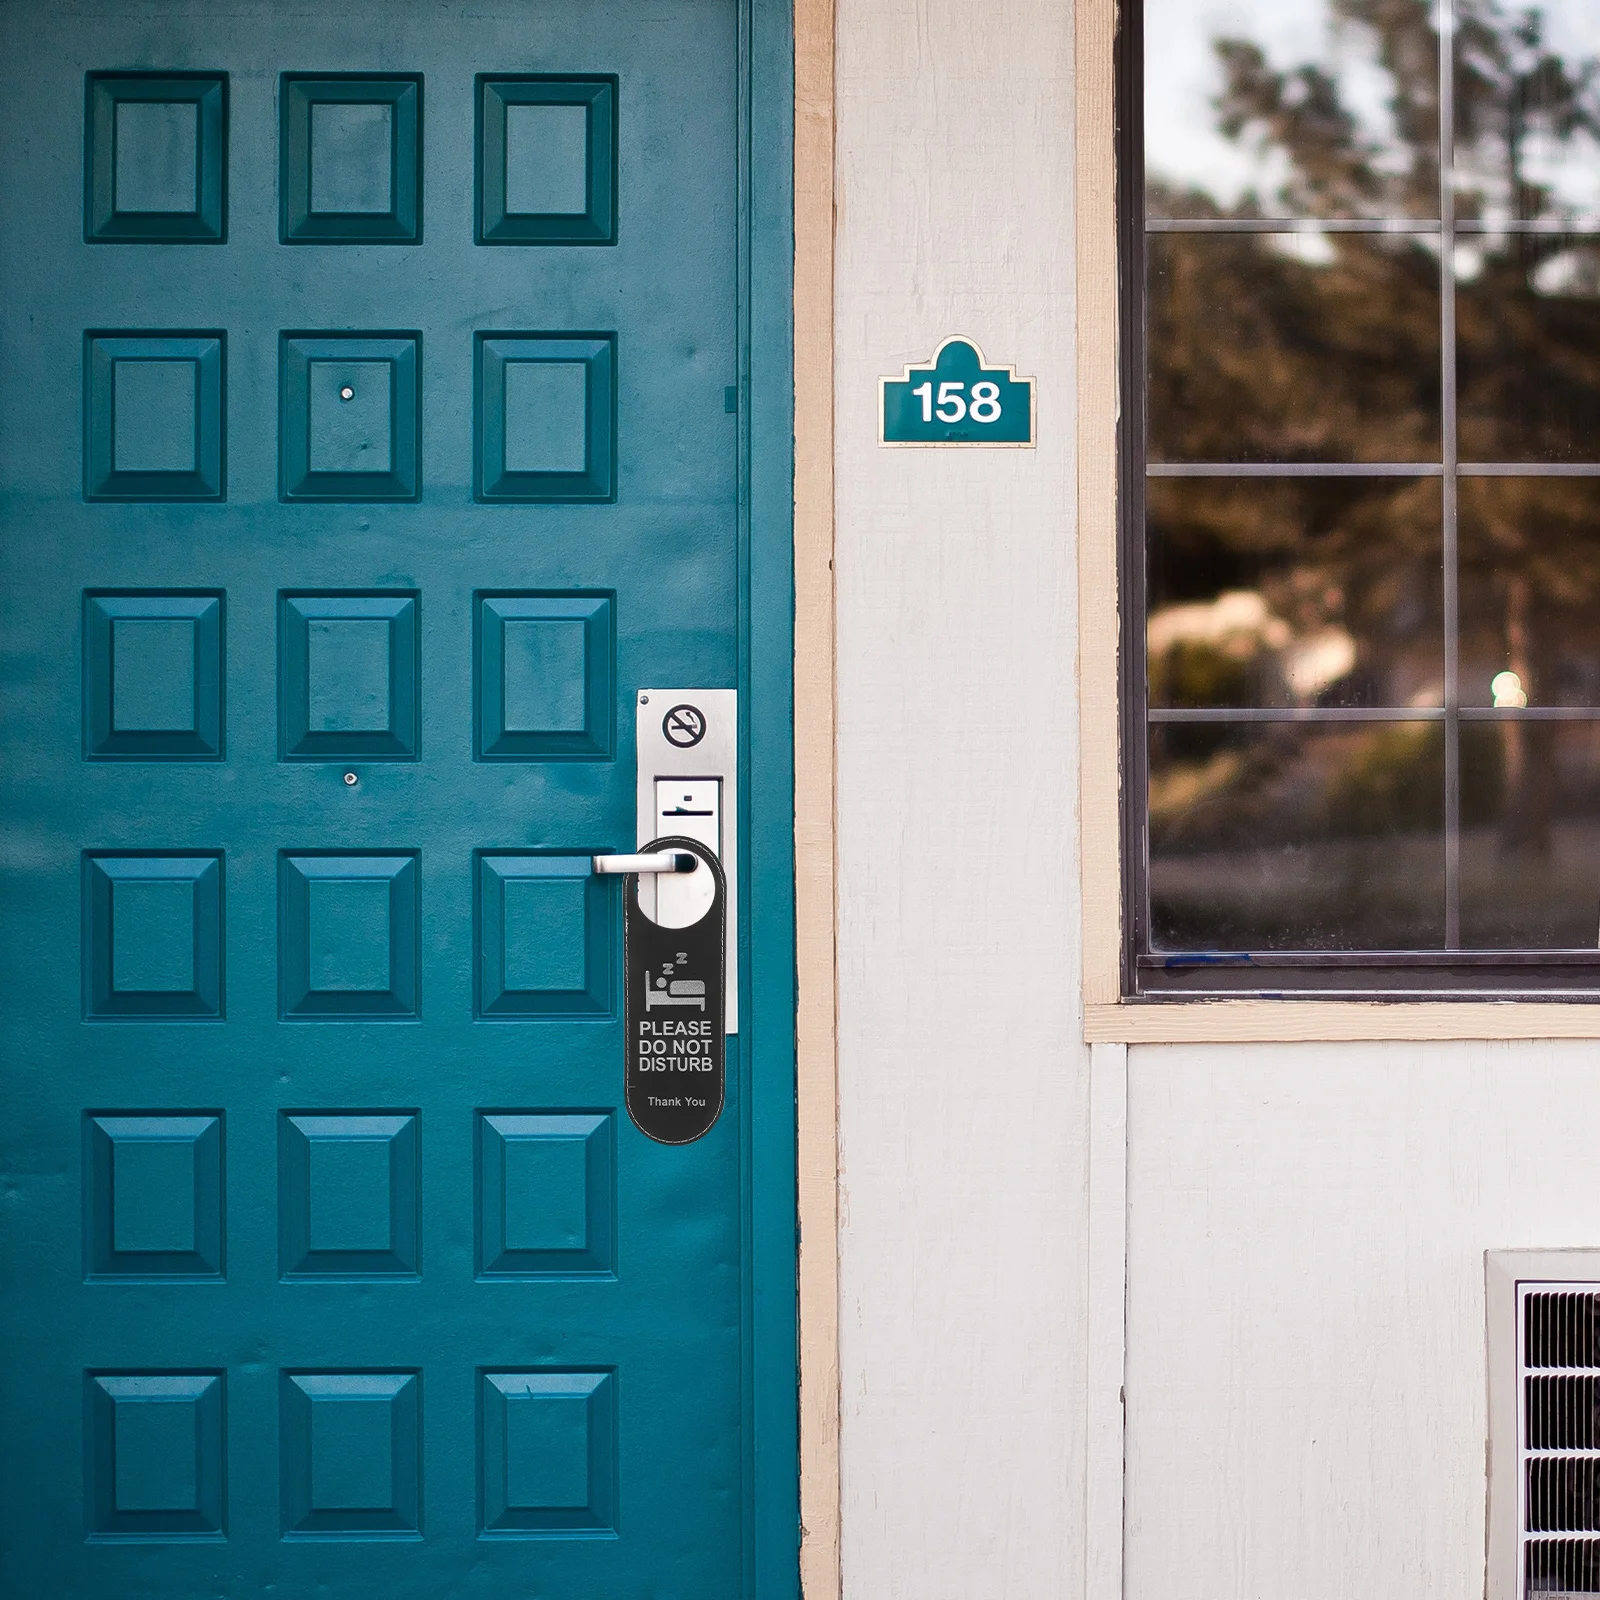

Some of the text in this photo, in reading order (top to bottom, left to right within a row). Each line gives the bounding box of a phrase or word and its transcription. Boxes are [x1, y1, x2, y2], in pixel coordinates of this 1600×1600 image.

[912, 381, 1002, 424] 158
[639, 1020, 712, 1036] PLEASE
[639, 1039, 713, 1055] DO NOT
[639, 1056, 713, 1072] DISTURB
[648, 1096, 706, 1107] Thank You
